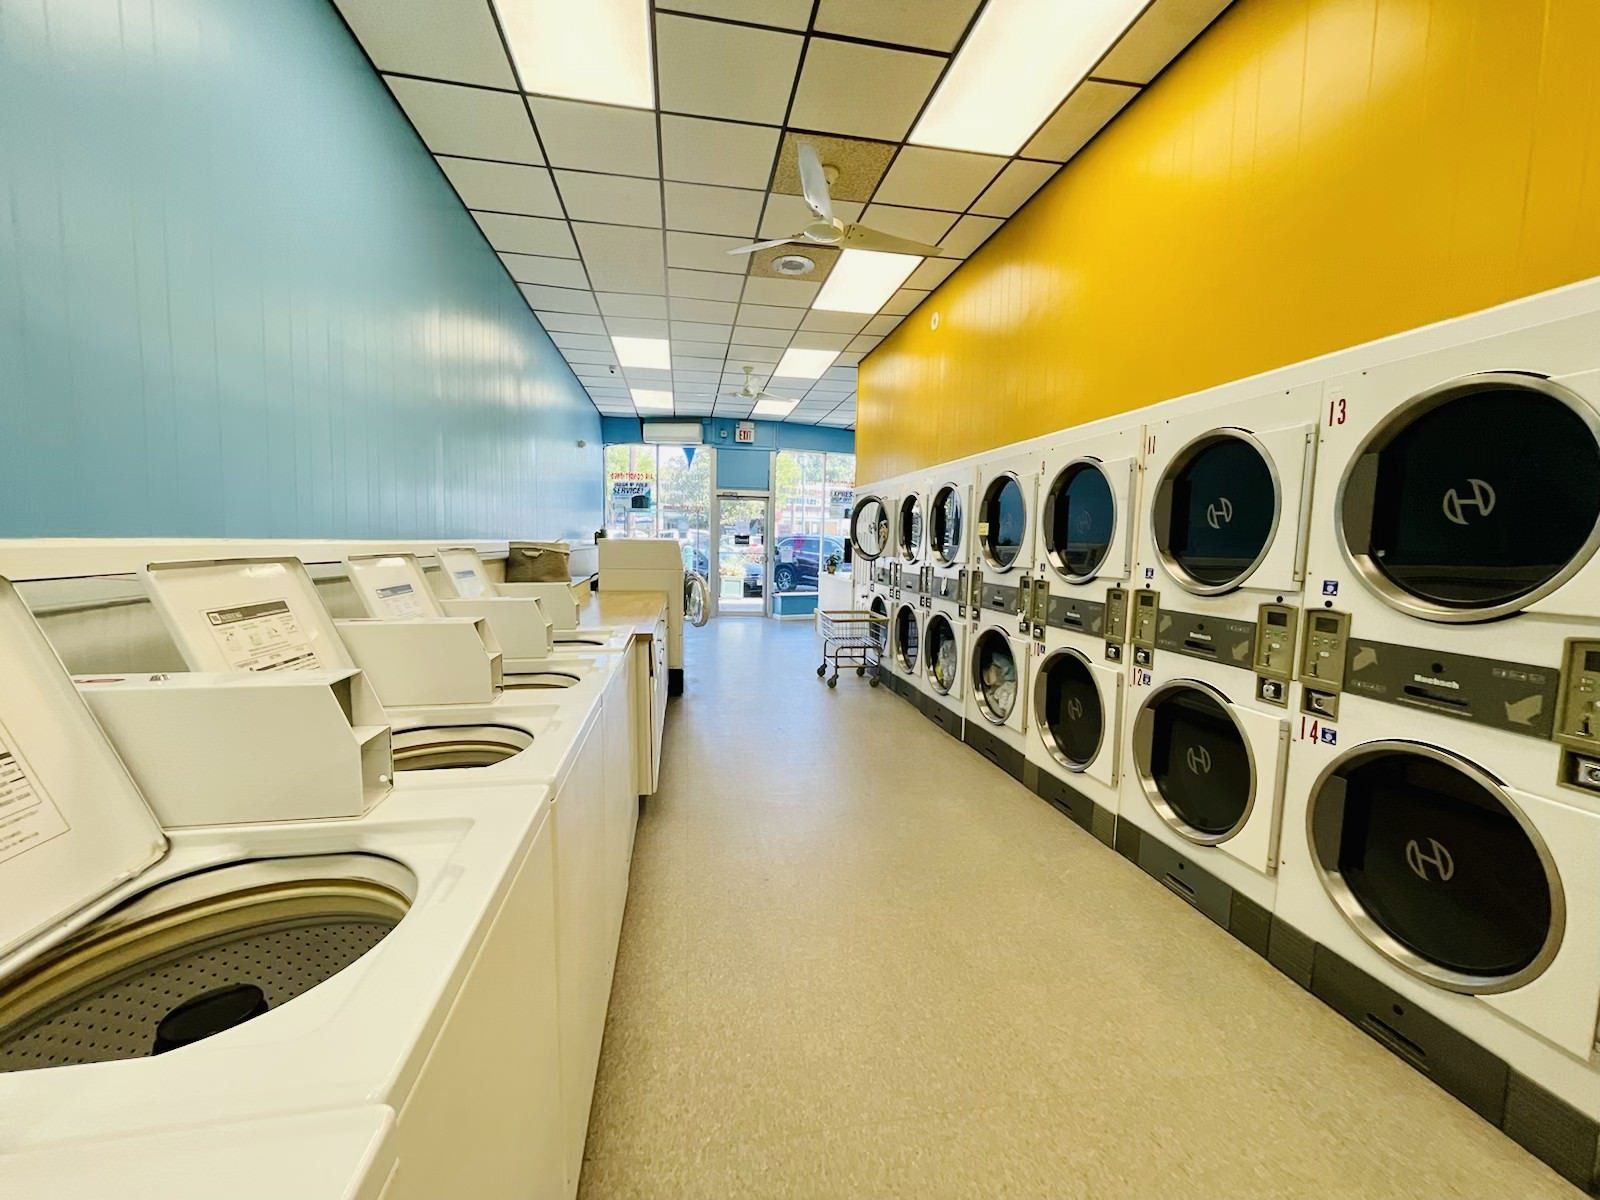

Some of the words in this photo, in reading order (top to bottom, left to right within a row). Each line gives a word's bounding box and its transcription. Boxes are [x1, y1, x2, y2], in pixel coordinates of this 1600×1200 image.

[1328, 398, 1346, 427] 13
[739, 430, 752, 440] EXIT
[1148, 435, 1156, 455] 11
[613, 487, 644, 495] SERVICE!
[1133, 668, 1143, 686] 12
[1301, 716, 1318, 745] 14
